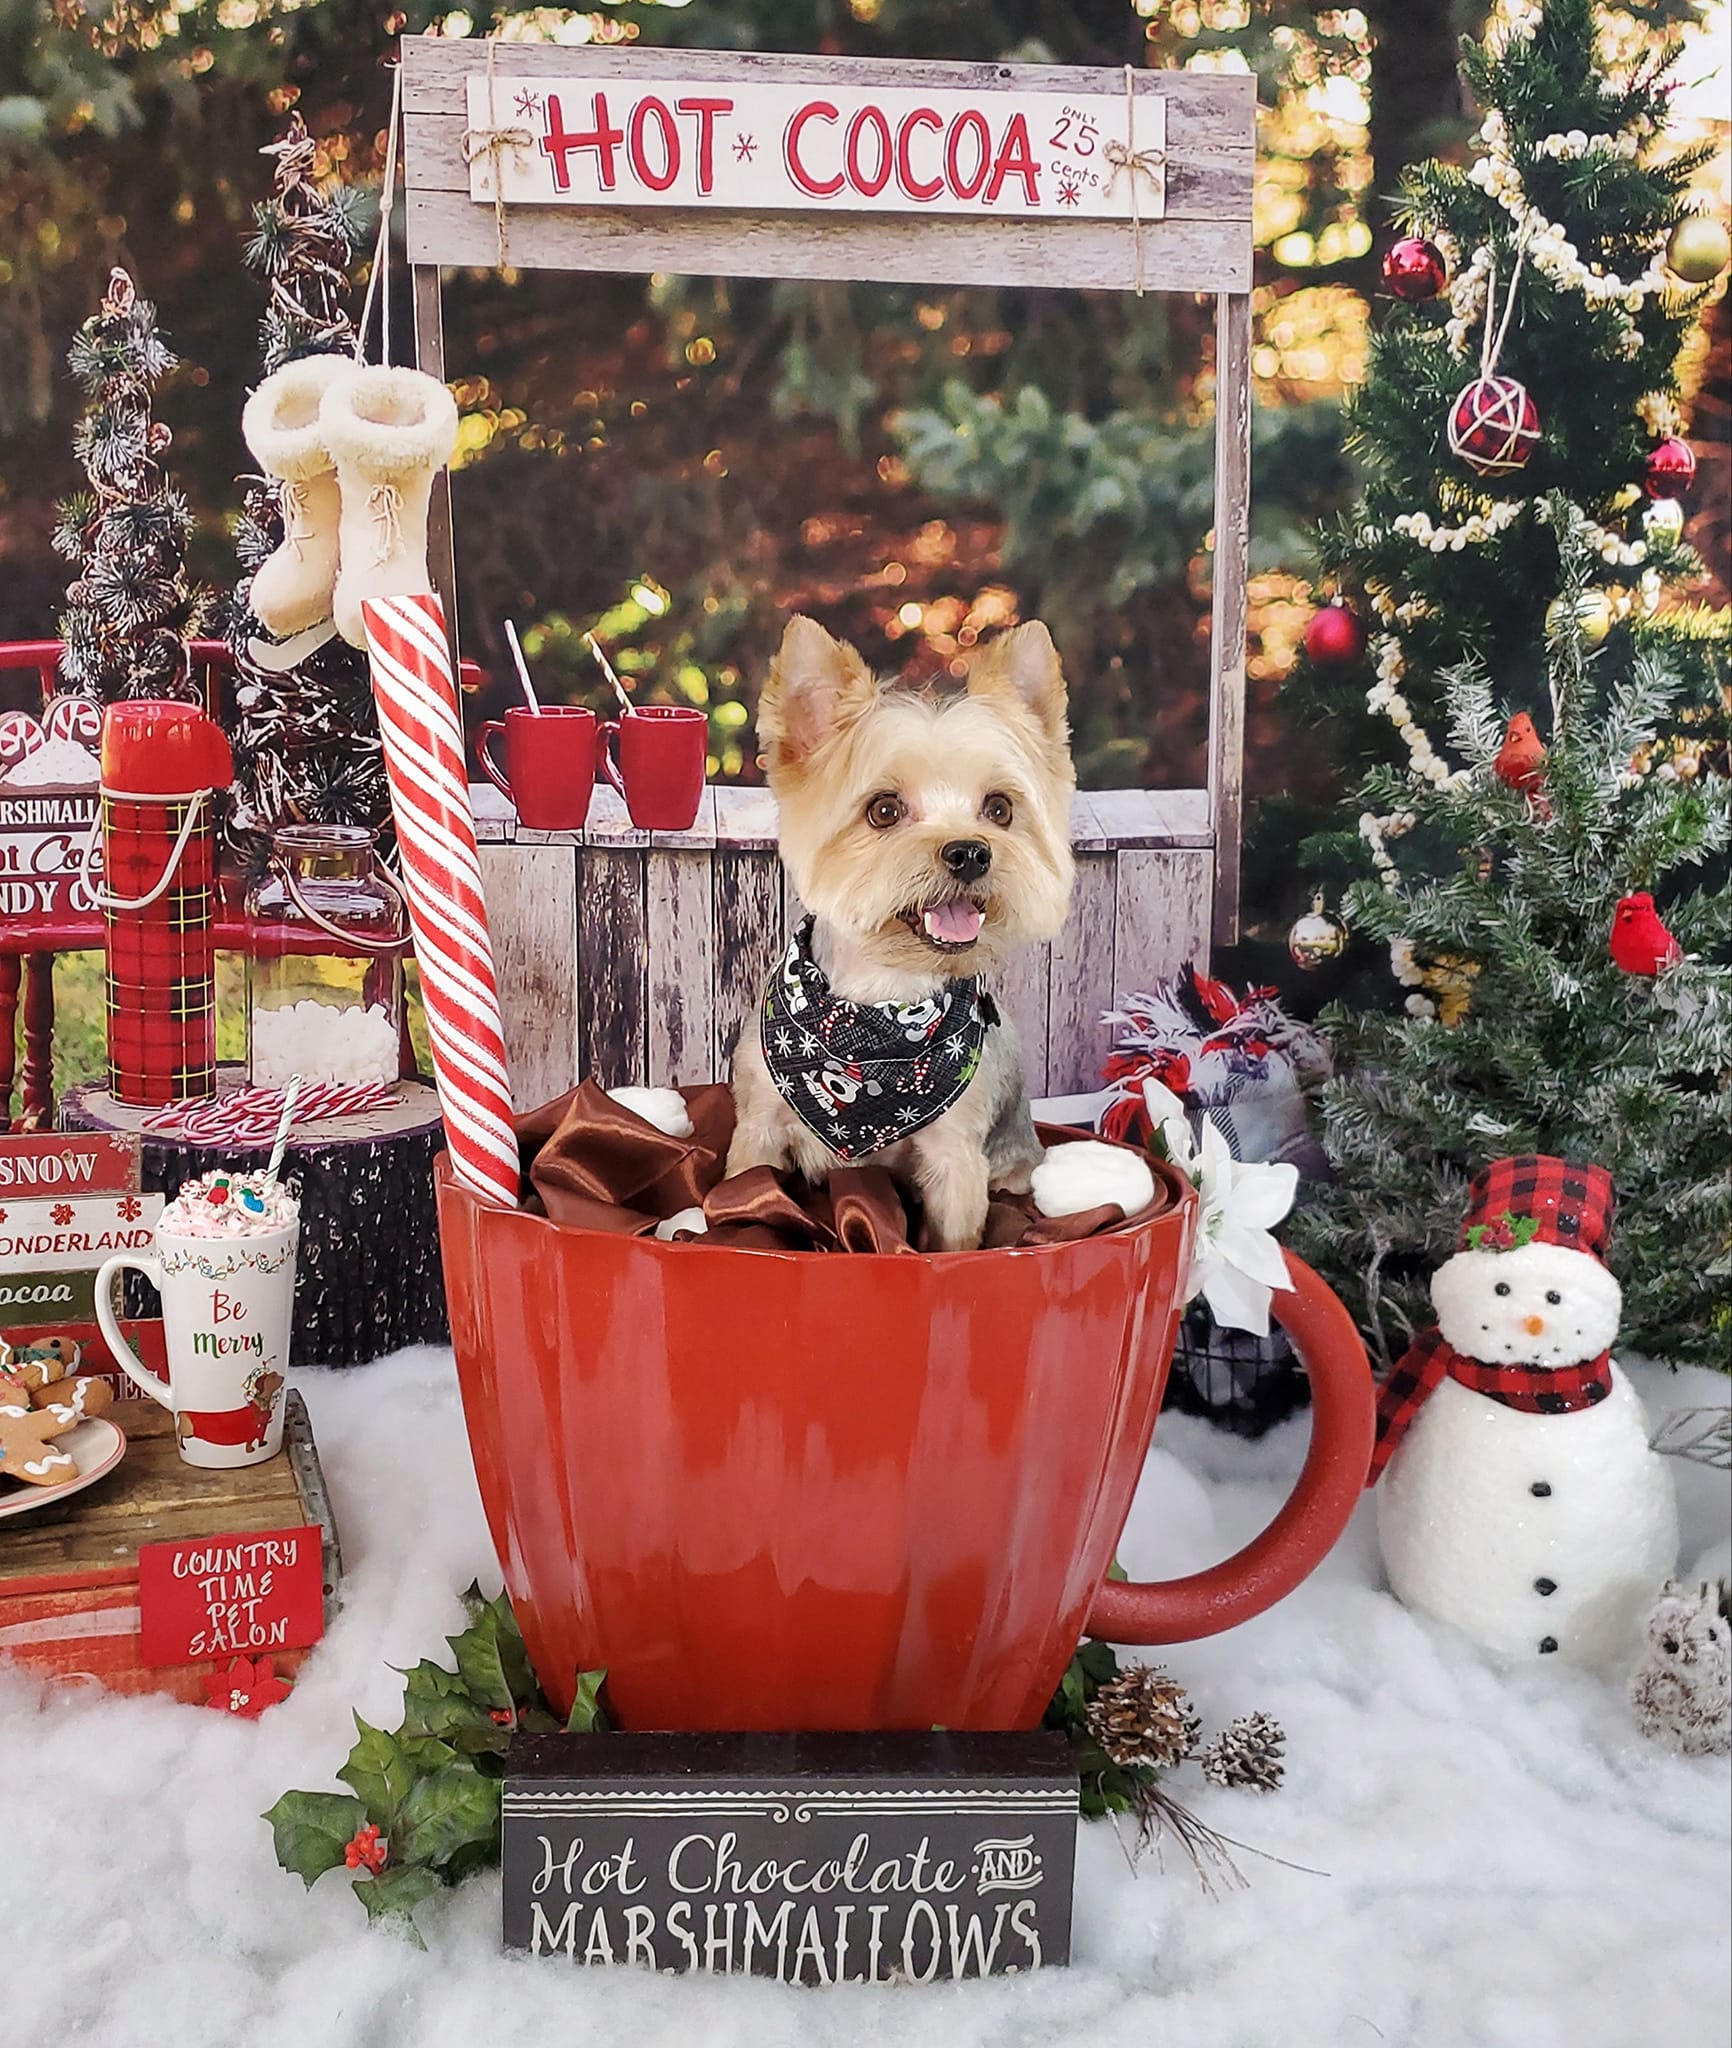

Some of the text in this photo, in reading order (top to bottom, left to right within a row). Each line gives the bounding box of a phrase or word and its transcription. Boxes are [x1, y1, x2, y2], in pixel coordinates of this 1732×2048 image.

[1062, 105, 1097, 125] ONLY
[538, 91, 1042, 206] HOT COCOA
[1049, 117, 1099, 156] 25
[1051, 160, 1100, 187] cents
[0, 1153, 98, 1187] SNOW
[209, 1289, 248, 1325] Be
[172, 1539, 298, 1579] COUNTRY
[198, 1570, 274, 1602] TIME
[206, 1598, 263, 1629] PET
[188, 1617, 289, 1657] SALON
[531, 1834, 648, 1895] Hot
[667, 1831, 967, 1895] Chocolate
[530, 1899, 1042, 1986] MARSHMALLOWS
